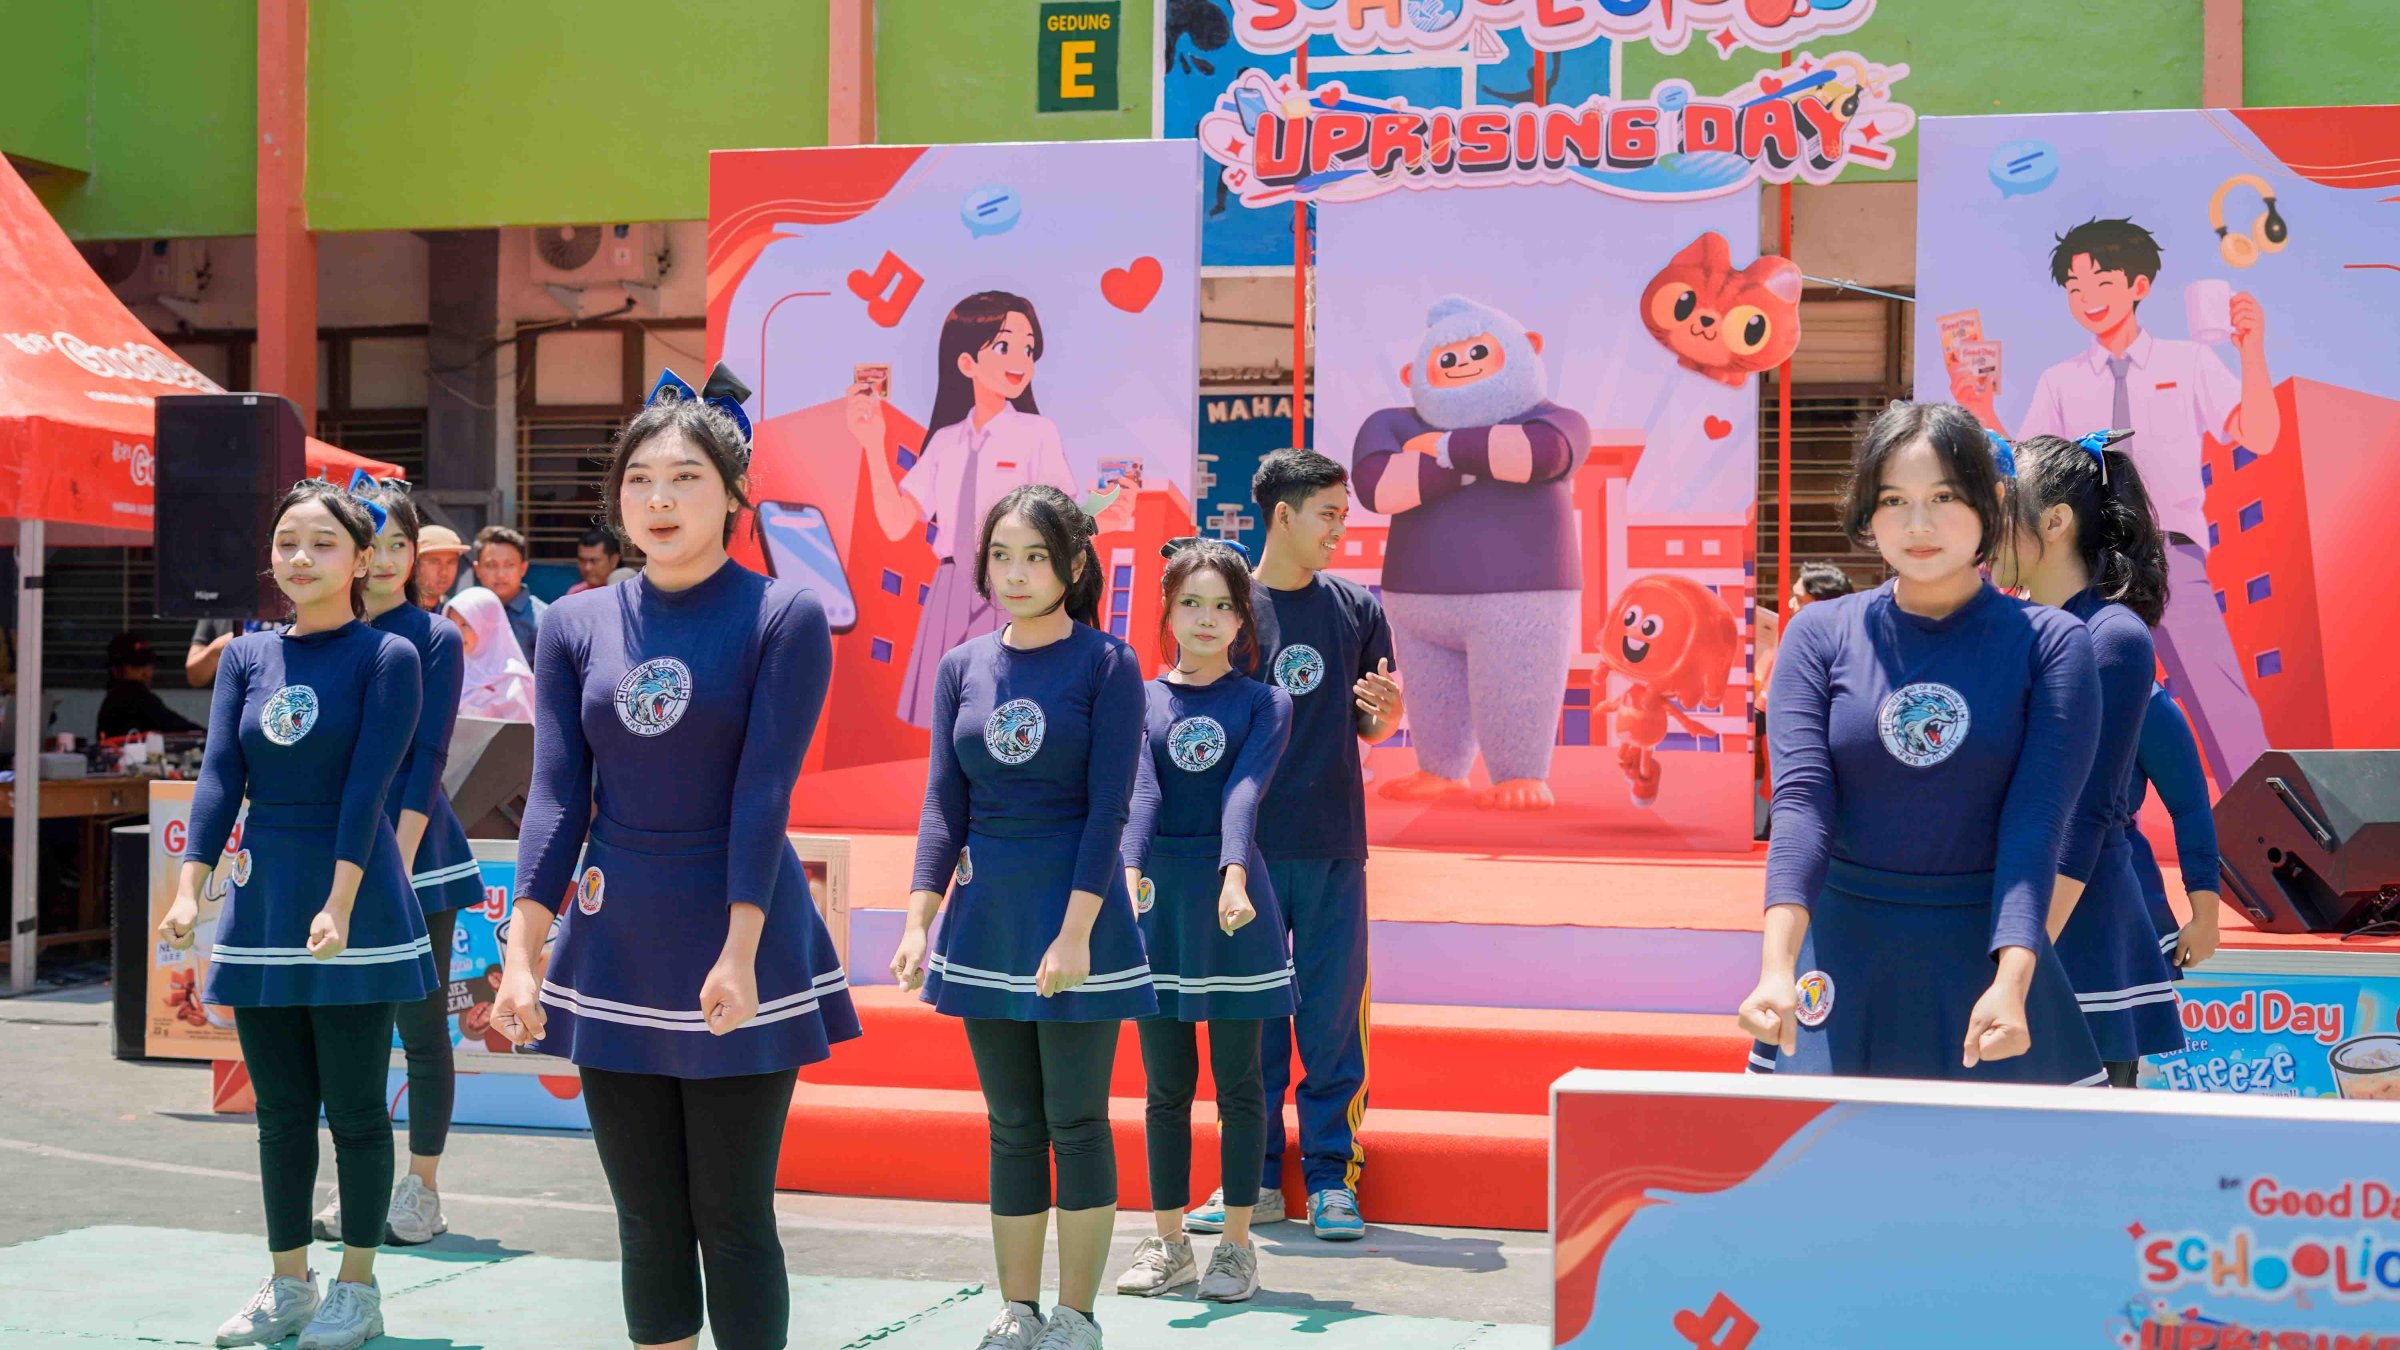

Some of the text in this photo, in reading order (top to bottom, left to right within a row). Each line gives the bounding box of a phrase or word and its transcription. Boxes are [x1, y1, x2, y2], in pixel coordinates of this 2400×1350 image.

[1047, 14, 1111, 31] GEDUNG
[1061, 40, 1096, 98] E
[1253, 95, 1852, 180] UPRISING DAY
[163, 820, 241, 853] Gd
[447, 995, 475, 1012] EAM
[2174, 992, 2341, 1043] ood Day
[2159, 1037, 2208, 1058] fee
[2159, 1052, 2295, 1093] Freeze
[2250, 1178, 2352, 1217] Good
